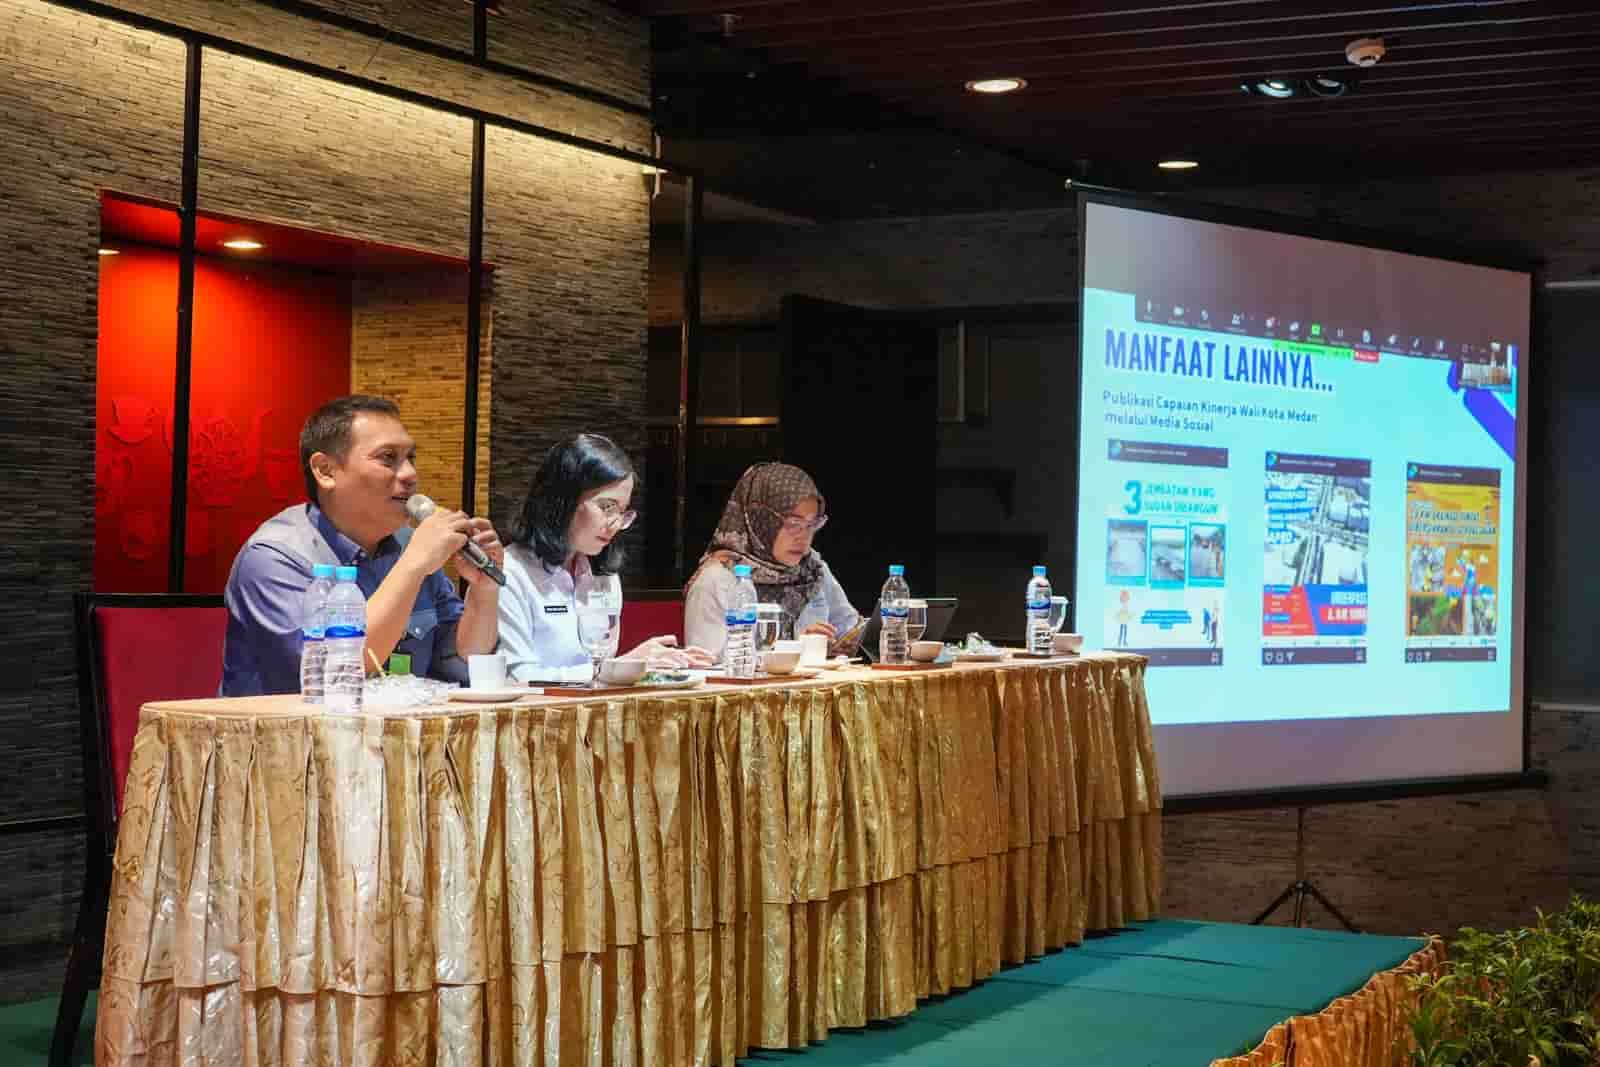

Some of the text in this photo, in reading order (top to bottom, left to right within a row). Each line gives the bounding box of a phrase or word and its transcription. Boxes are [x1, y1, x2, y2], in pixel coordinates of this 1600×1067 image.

[1104, 328, 1216, 379] MANFAAT
[1223, 343, 1334, 392] LAINNYA...
[1103, 390, 1318, 423] Publikasi Capaian Kinerja Wali Kota Medan
[1104, 409, 1215, 432] melalui Media Sosial
[1124, 480, 1142, 514] 3
